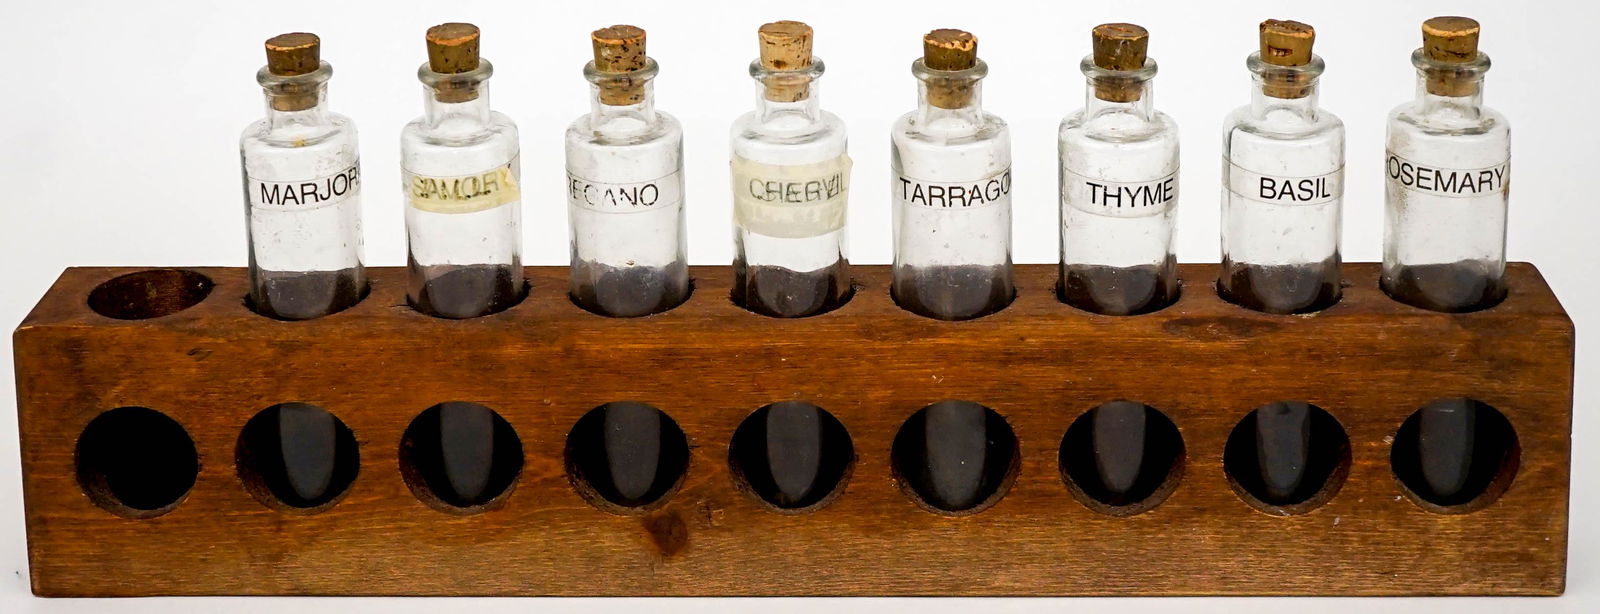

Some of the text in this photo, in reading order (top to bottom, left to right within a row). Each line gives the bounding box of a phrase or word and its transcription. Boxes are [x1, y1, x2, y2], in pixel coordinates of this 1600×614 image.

[899, 171, 1010, 208] TARRAGO
[1086, 178, 1174, 208] THYME
[1259, 176, 1331, 201] BASIL
